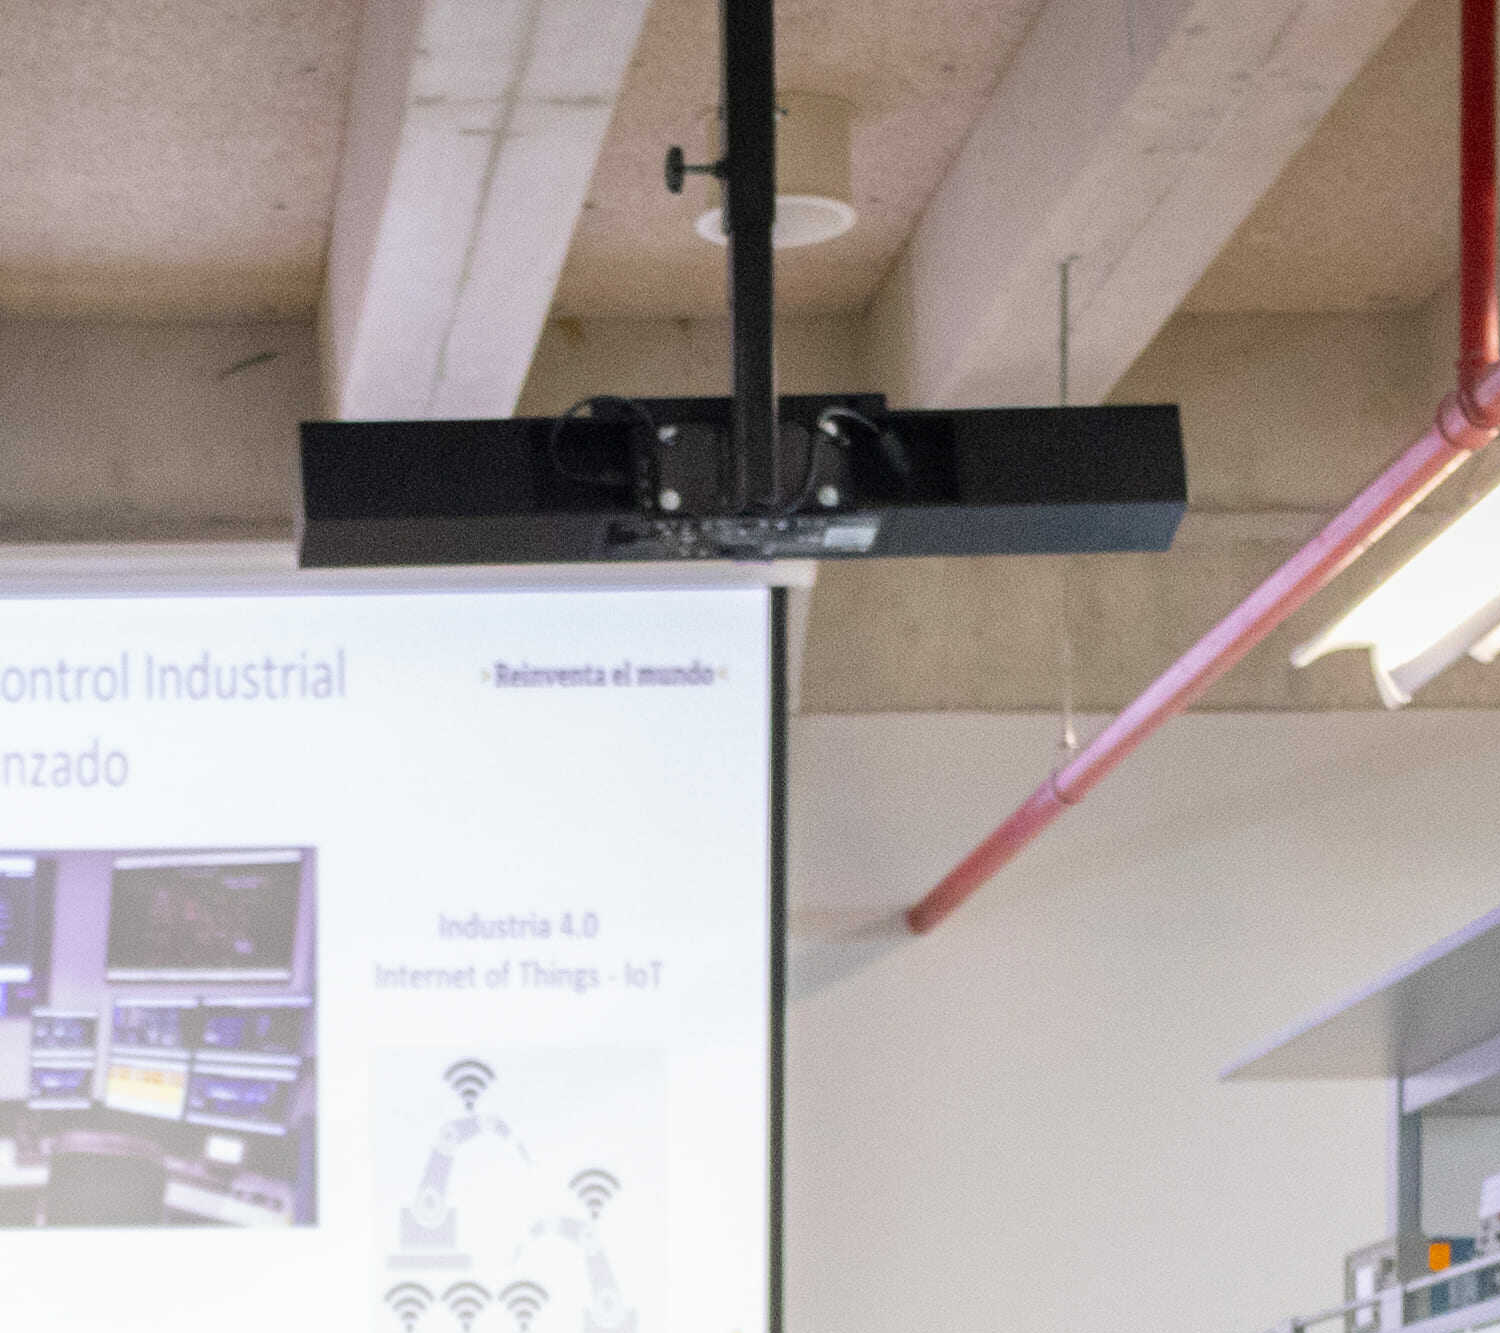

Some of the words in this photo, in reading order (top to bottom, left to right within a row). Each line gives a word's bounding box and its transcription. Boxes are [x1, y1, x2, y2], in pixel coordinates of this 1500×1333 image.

[145, 648, 347, 701] Industrial
[493, 659, 606, 688] Reinventa
[611, 660, 631, 687] el
[636, 660, 715, 686] mundo
[437, 911, 552, 941] Industria
[558, 911, 601, 939] 4.0
[373, 959, 477, 990] Internet
[484, 958, 512, 989] of
[517, 958, 601, 994] Things
[623, 958, 665, 990] IoT
